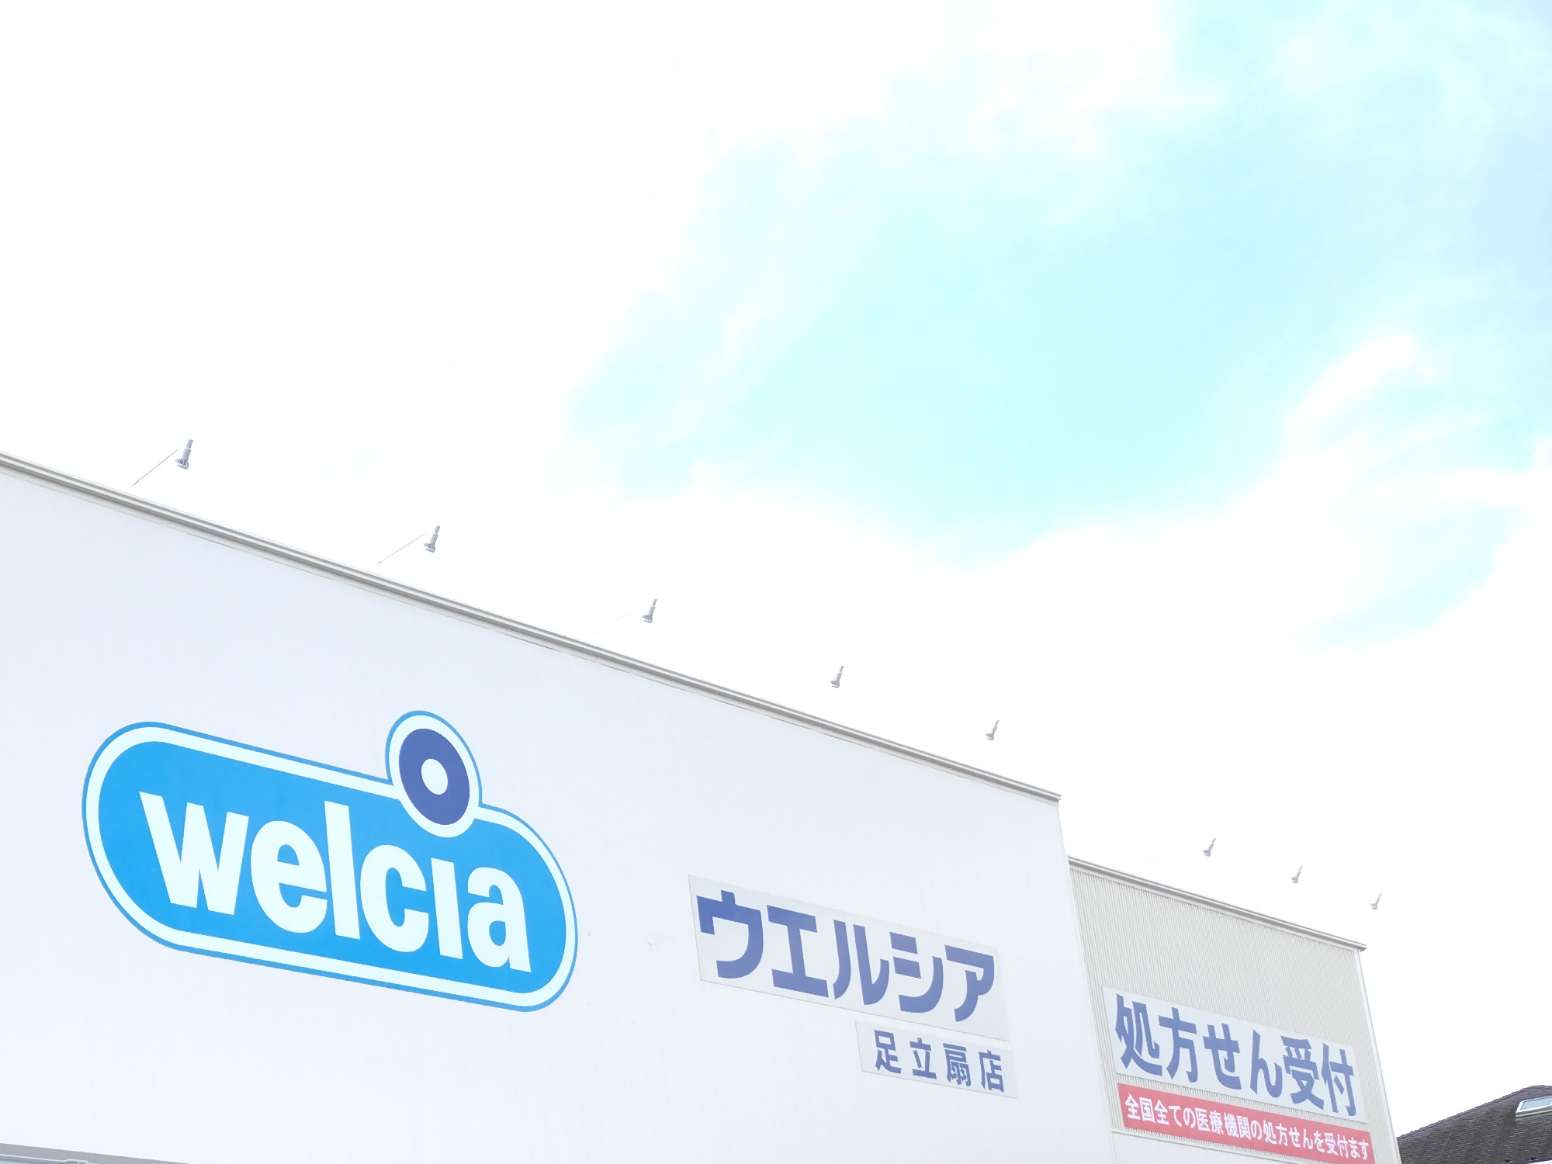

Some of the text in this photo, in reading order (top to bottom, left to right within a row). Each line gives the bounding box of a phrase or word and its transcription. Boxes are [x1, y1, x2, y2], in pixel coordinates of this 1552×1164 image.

[138, 728, 532, 974] welcia
[696, 889, 996, 1022] ウエルシア
[873, 1028, 1005, 1093] 足立扇店
[1115, 993, 1357, 1117] 処方せん受付
[1124, 1094, 1370, 1161] 全国全ての医療機関の処方せんを受付ます
